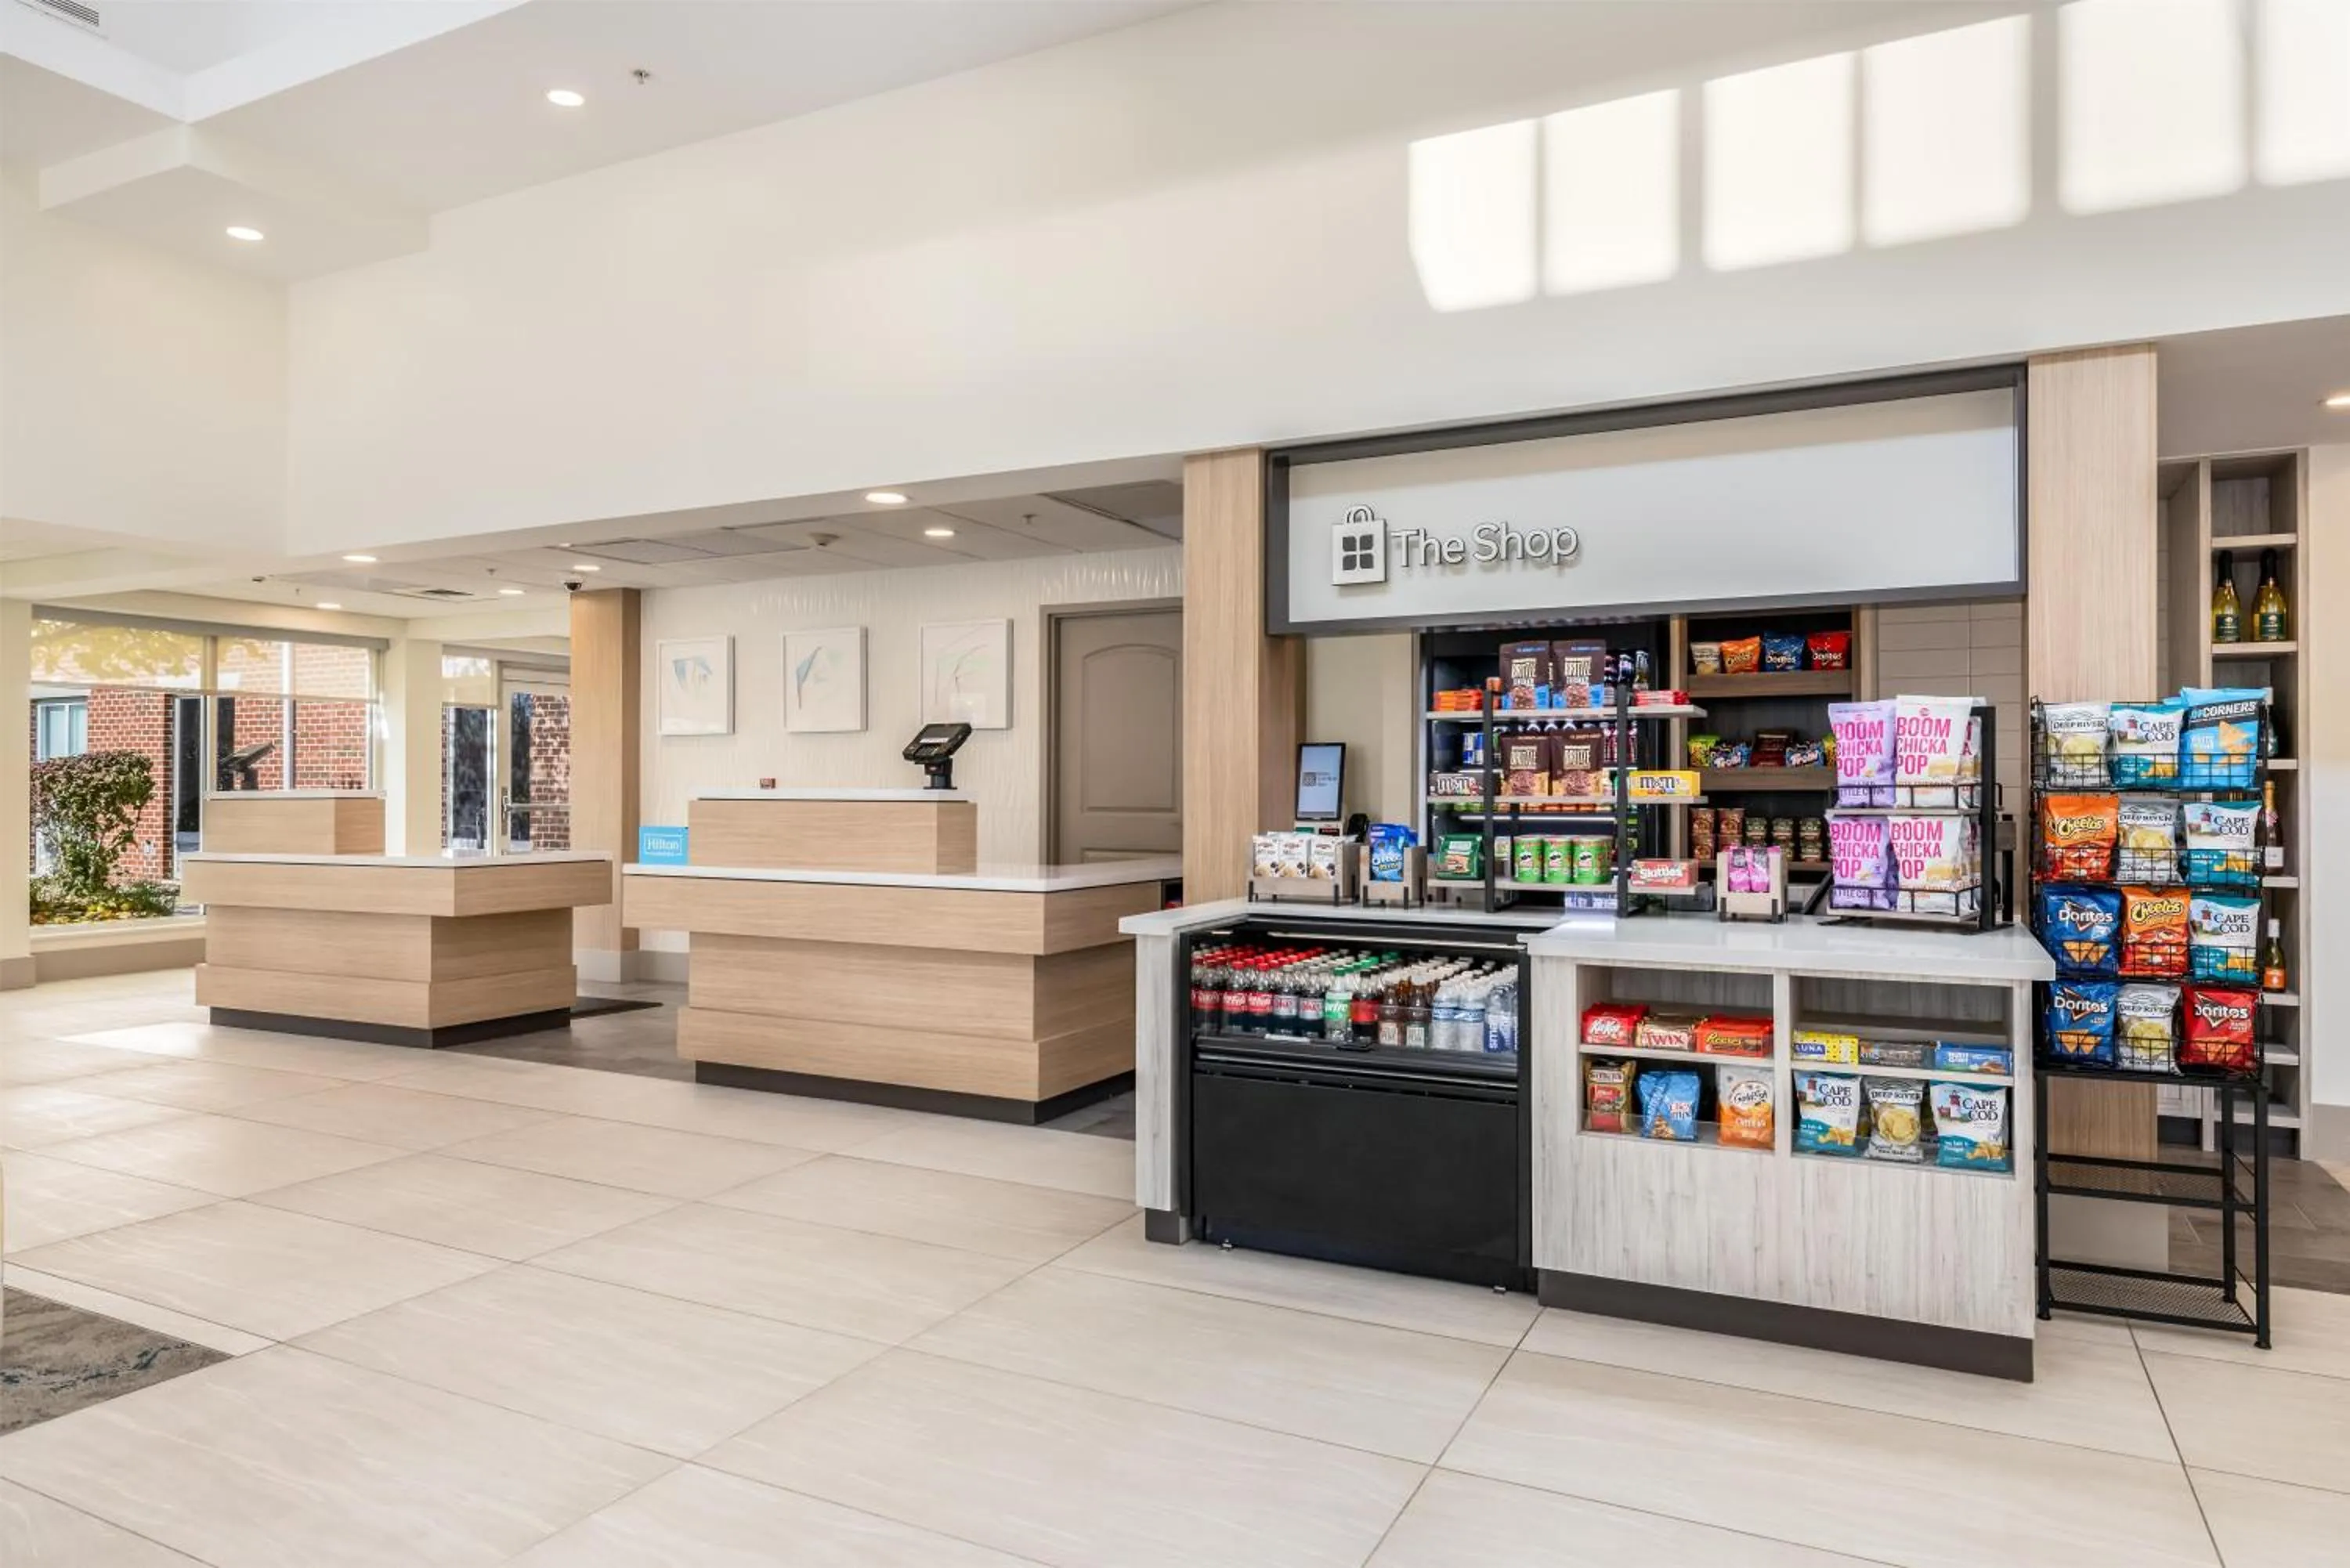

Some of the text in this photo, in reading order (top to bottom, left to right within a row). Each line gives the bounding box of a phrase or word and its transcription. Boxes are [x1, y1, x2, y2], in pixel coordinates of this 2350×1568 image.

[1390, 522, 1578, 567] The Shop
[1833, 720, 1884, 740] BOOM
[1896, 717, 1952, 738] BOOM
[2077, 720, 2106, 728] RIVER
[2139, 721, 2175, 732] CAPE
[2145, 732, 2175, 742] COD
[1836, 740, 1883, 757] CHICKA
[1896, 737, 1947, 754] CHICKA
[1837, 757, 1867, 778] POP
[1896, 754, 1929, 775] POP
[2056, 817, 2106, 837] Cheetos
[2214, 815, 2251, 827] CAPE
[1831, 822, 1882, 842] BOOM
[1891, 820, 1944, 842] BOOM
[2219, 826, 2250, 836] COD
[647, 836, 679, 850] Hilton
[1830, 842, 1879, 859] CHICKA
[1640, 865, 1683, 880] Skittles
[1901, 859, 1925, 880] OP
[2059, 908, 2114, 923] Doritos
[2131, 900, 2184, 923] Cheetos
[2214, 913, 2250, 923] CAPE
[2219, 923, 2251, 934] COD
[2054, 995, 2109, 1013] Doritos
[1795, 1044, 1824, 1053] LUNA
[1819, 1083, 1852, 1097] CAPE
[1823, 1096, 1853, 1107] COD
[1962, 1097, 1998, 1111] CAPE
[1969, 1110, 1998, 1121] COD
